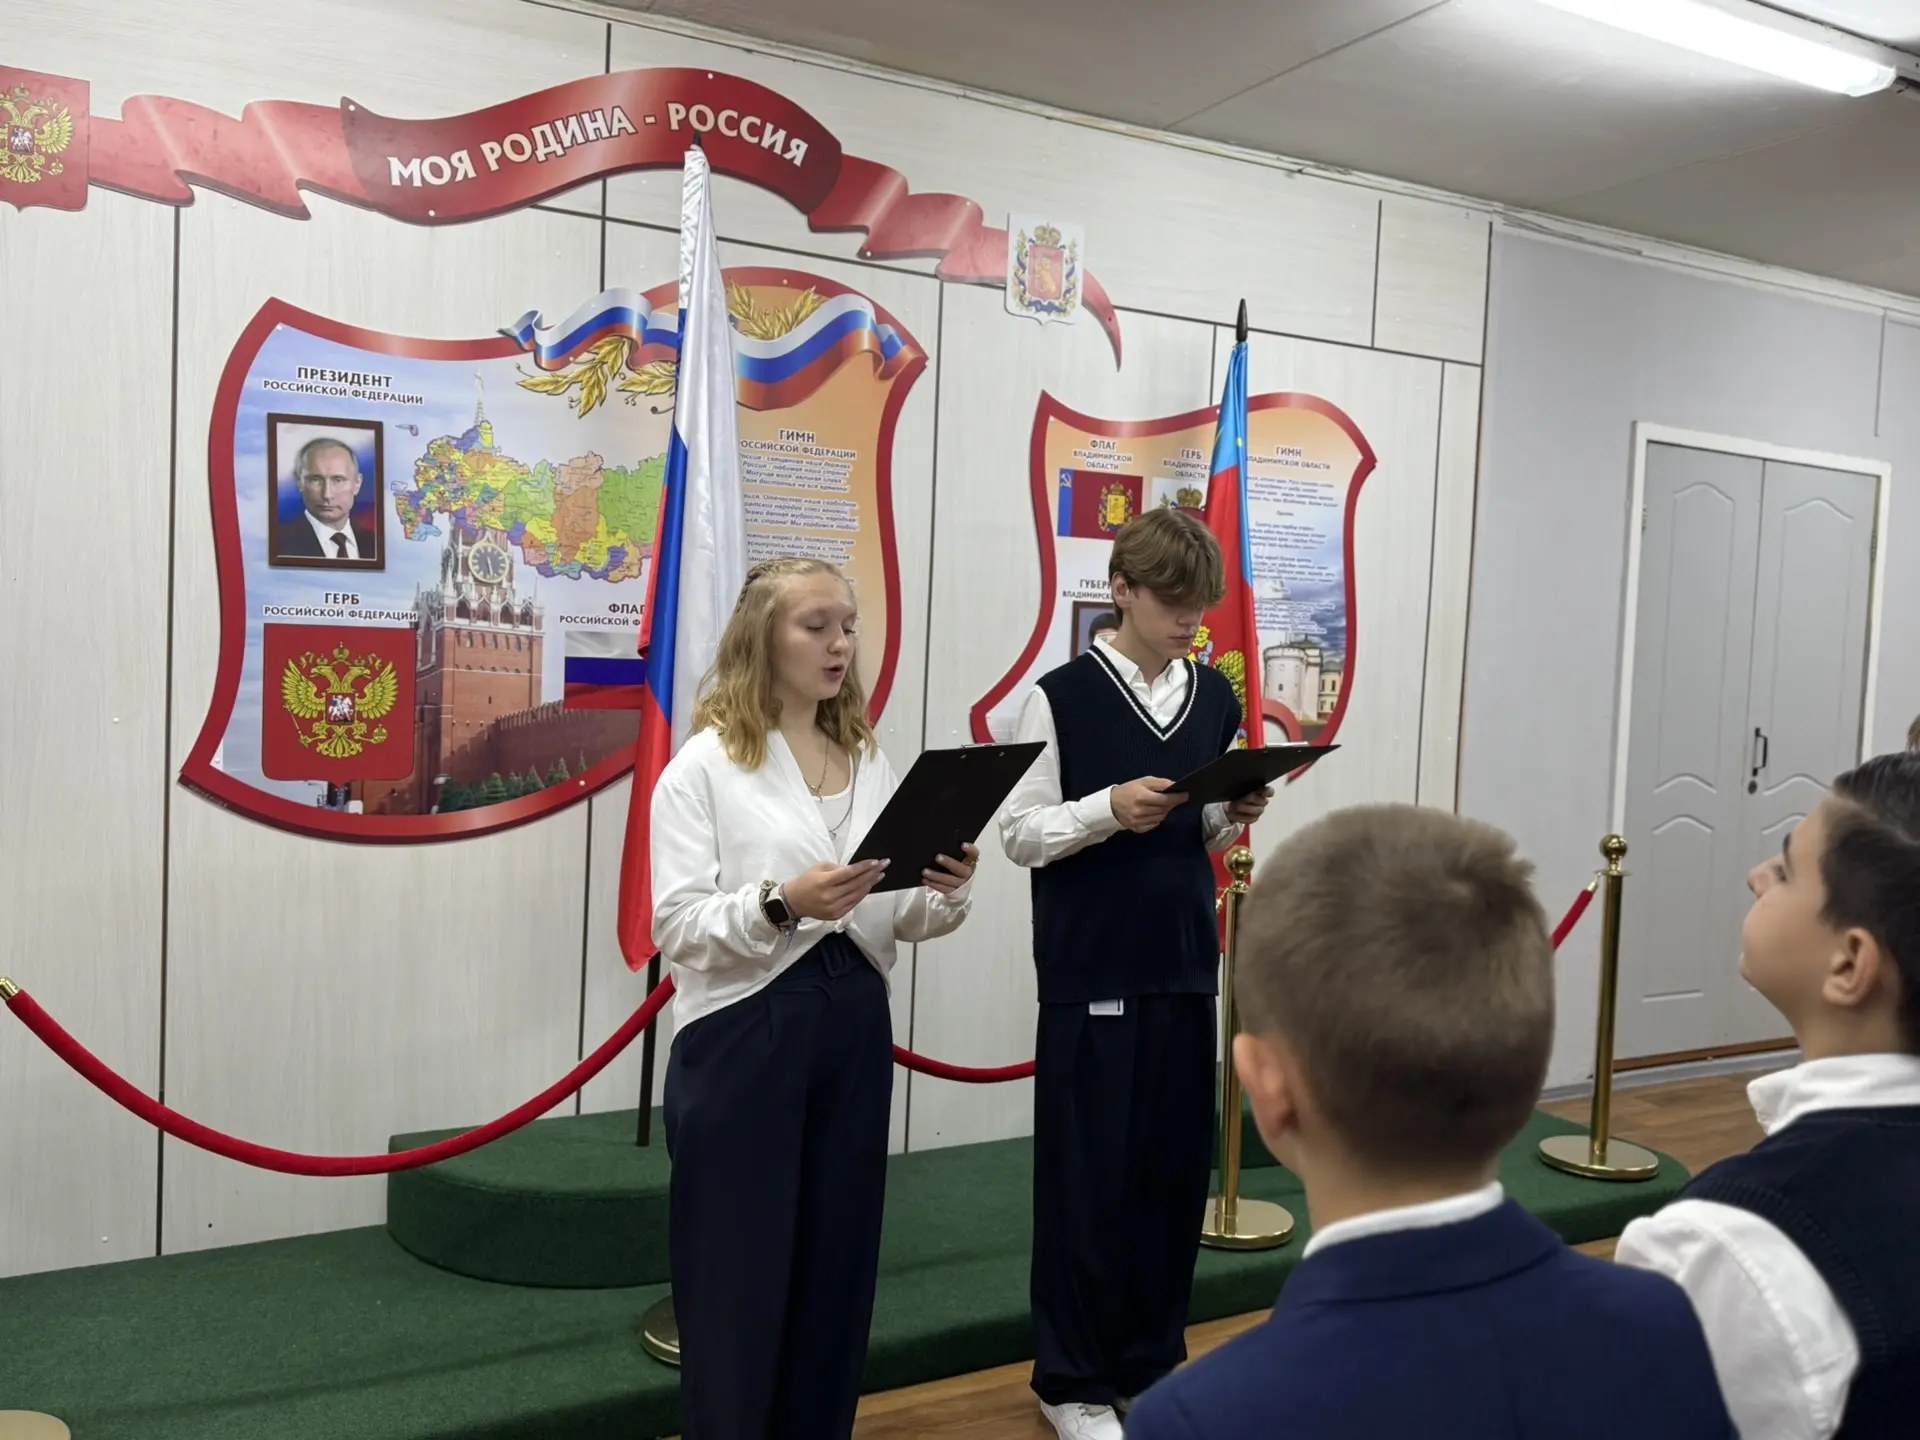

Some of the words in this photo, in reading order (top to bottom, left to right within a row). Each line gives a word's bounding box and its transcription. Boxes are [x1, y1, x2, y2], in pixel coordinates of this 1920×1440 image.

[388, 148, 476, 187] МОЯ
[480, 105, 638, 172] РОДИНА
[644, 112, 656, 125] -
[666, 102, 809, 167] РОССИЯ
[297, 367, 393, 388] ПРЕЗИДЕНТ
[264, 380, 347, 397] РОССИЙСКОЙ
[351, 389, 423, 405] ФЕДЕРАЦИИ
[779, 429, 815, 443] ГИМН
[740, 440, 799, 454] ОССИЙСКОЙ
[801, 446, 857, 459] ФЕДЕРАЦИИ
[1090, 440, 1117, 450] ФЛАГ
[1181, 449, 1202, 459] ГЕРБ
[1276, 447, 1302, 457] ГИМН
[1086, 461, 1119, 470] ОБЛАСТИ
[1247, 456, 1299, 467] ЛАДИМИРСКОЙ
[324, 592, 360, 605] ГЕРБ
[1063, 590, 1112, 600] ВЛАДИМИРСК
[264, 605, 344, 618] РОССИЙСКОЙ
[348, 609, 417, 622] ФЕДЕРАЦИИ
[608, 603, 645, 615] ФЛАГ
[559, 614, 629, 626] РОССИЙСКОЙ
